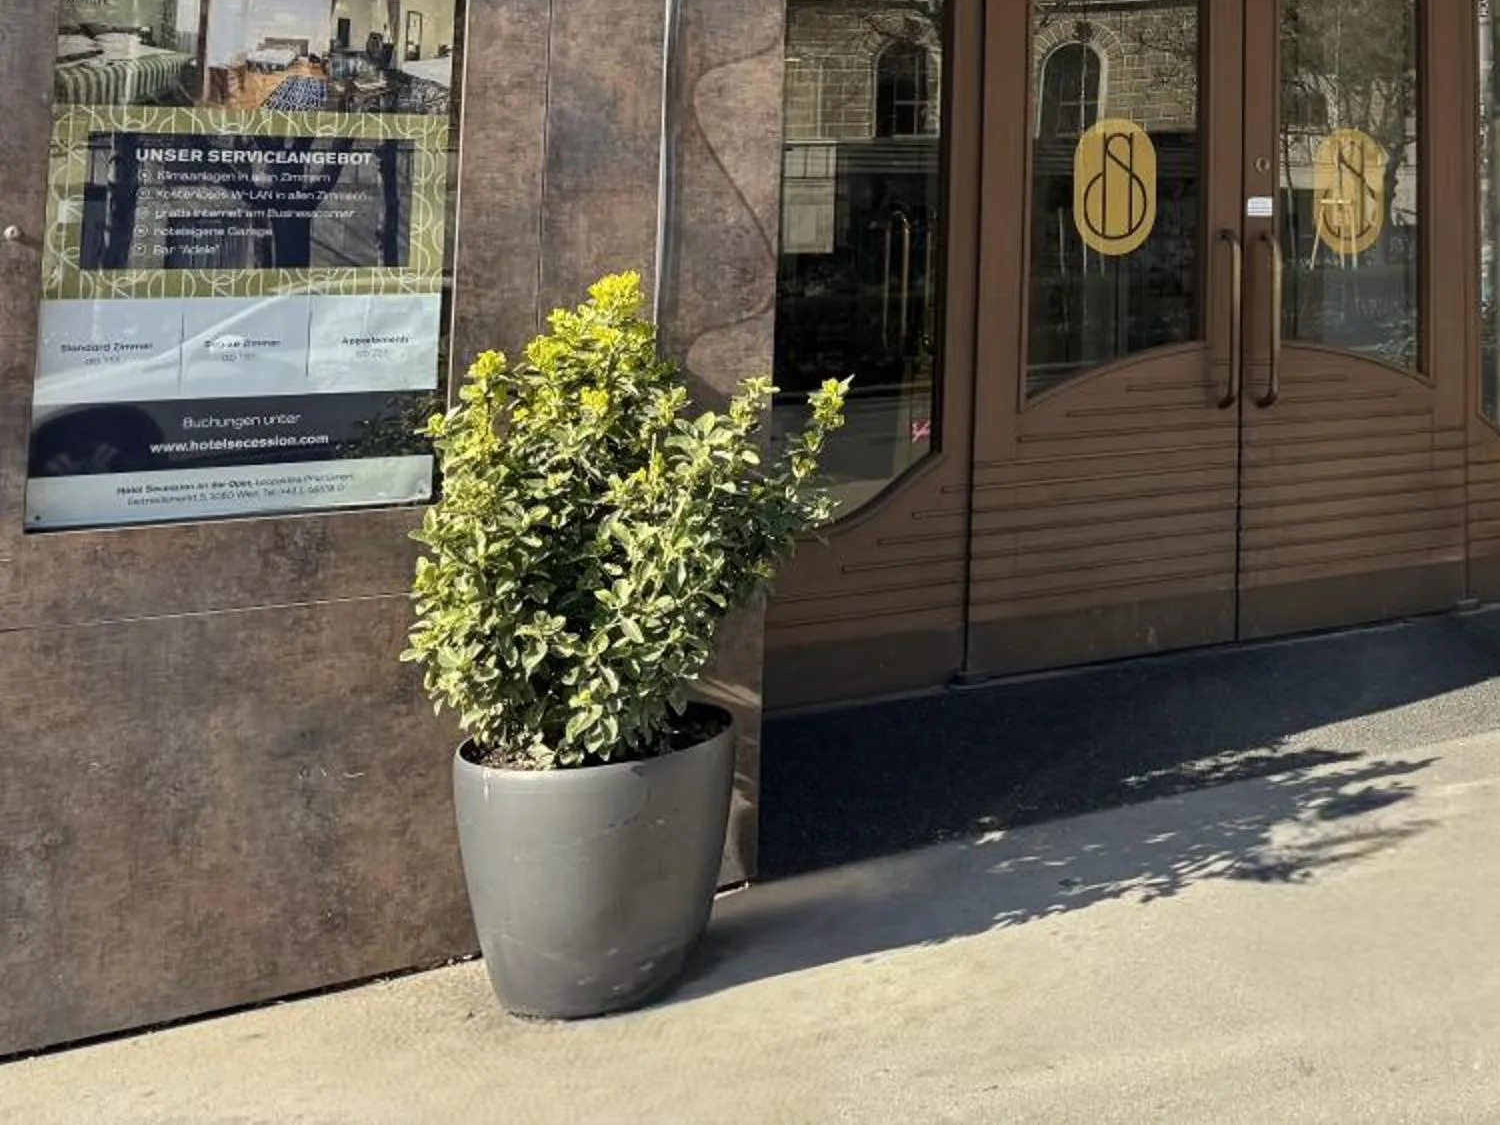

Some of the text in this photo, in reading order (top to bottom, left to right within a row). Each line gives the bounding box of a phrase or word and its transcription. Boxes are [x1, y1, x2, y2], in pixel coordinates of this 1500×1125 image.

[135, 148, 373, 166] UNSER SERVICEANGEBOT
[183, 412, 301, 430] Buchungen unter
[150, 433, 330, 455] www.hotelsecession.com
